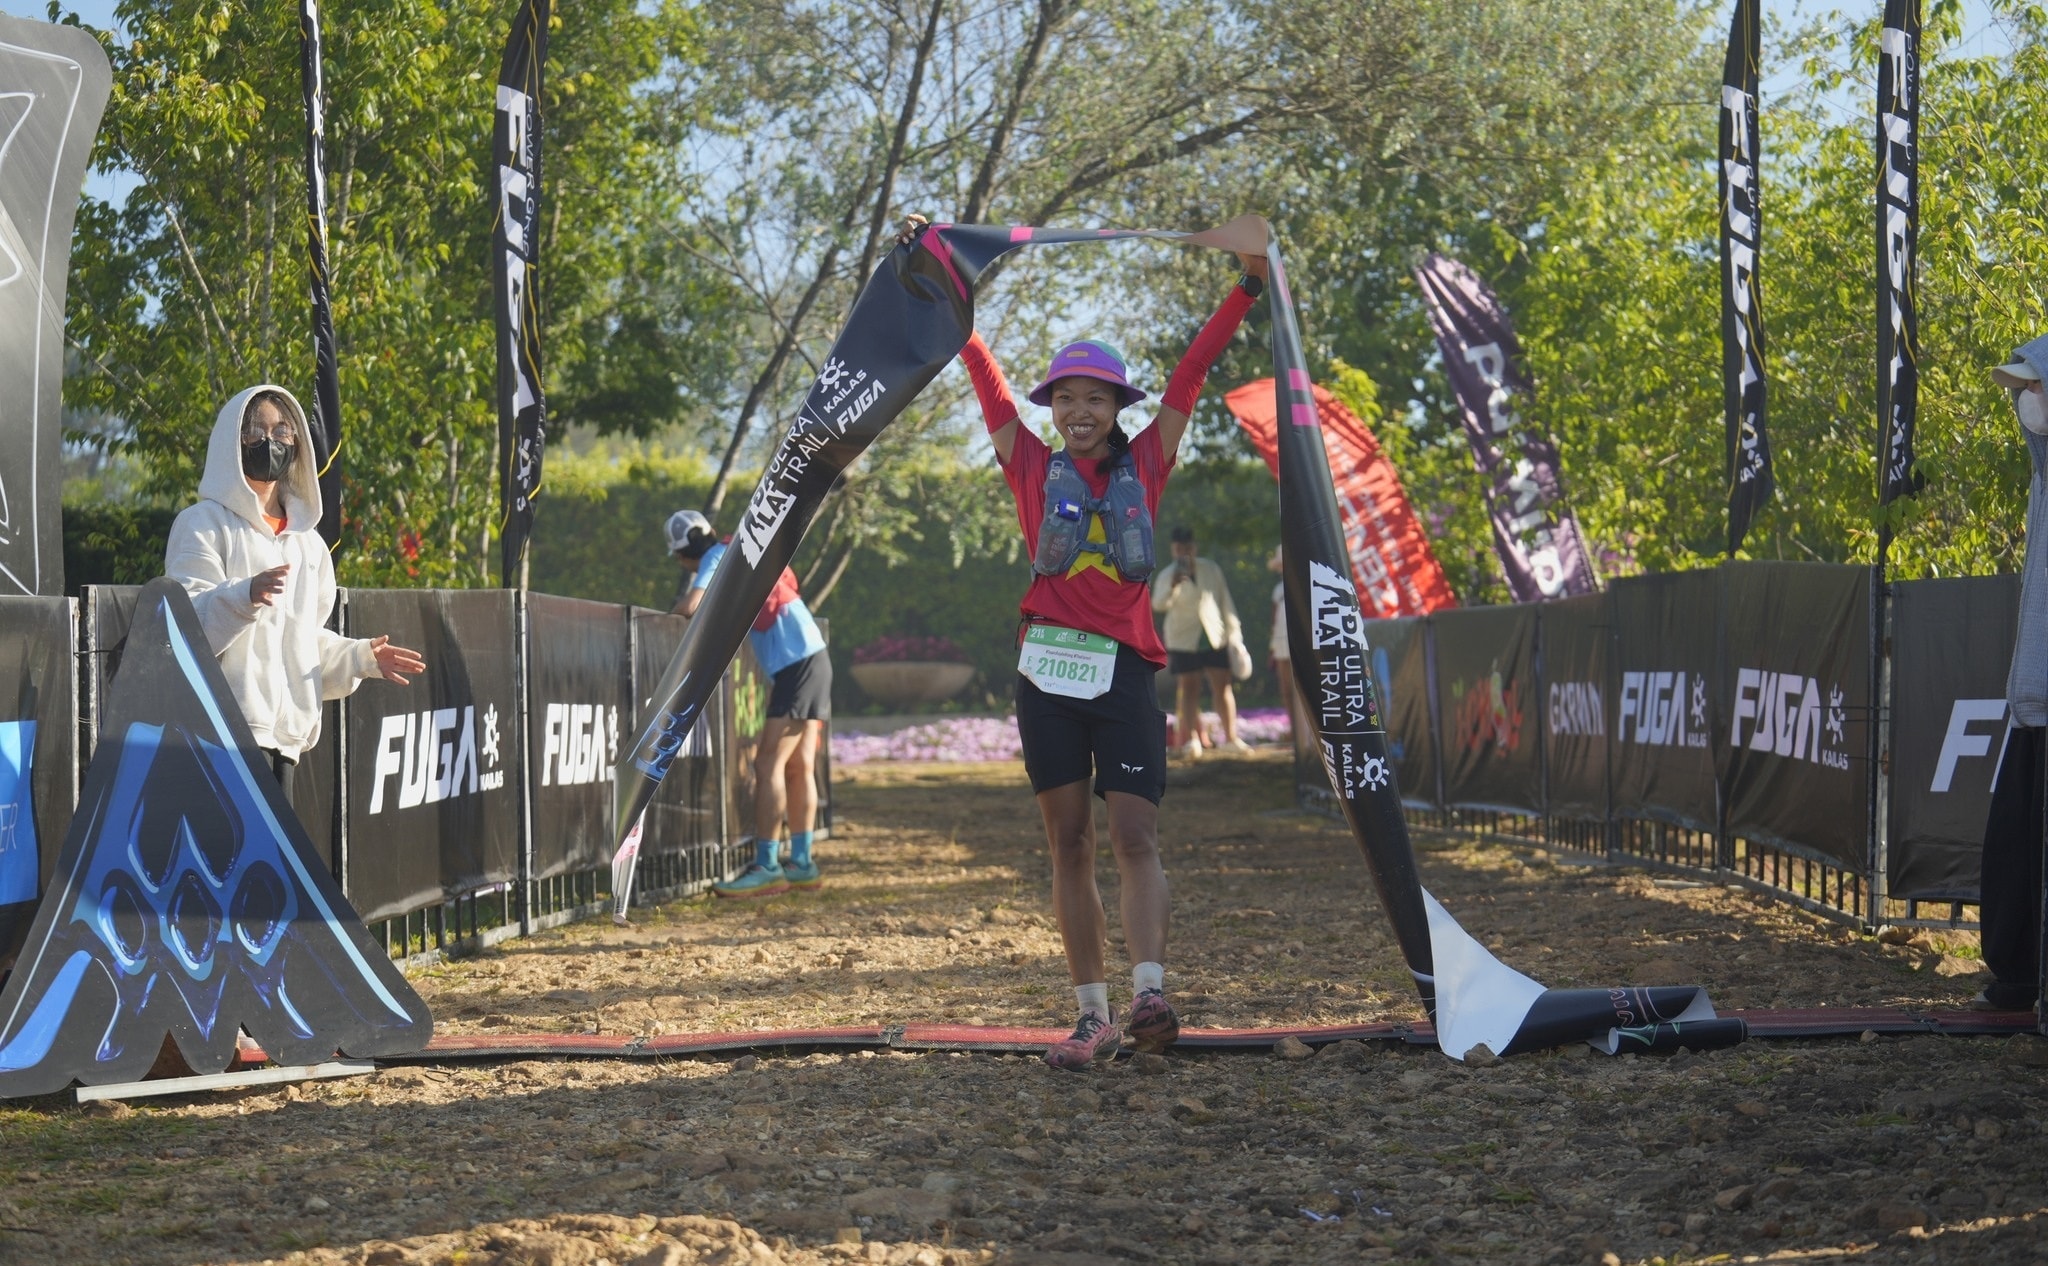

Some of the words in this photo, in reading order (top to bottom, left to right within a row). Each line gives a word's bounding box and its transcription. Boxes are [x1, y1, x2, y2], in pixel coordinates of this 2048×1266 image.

[823, 369, 867, 414] KAILAS
[836, 379, 887, 434] FUGA
[780, 432, 830, 484] TRAIL
[1036, 656, 1098, 684] 210821
[1319, 655, 1342, 727] TRAIL
[1343, 655, 1366, 727] ULTRA
[1618, 671, 1686, 747] FUGA
[1730, 667, 1821, 764] FUGA
[370, 705, 478, 815] FUGA
[542, 703, 606, 787] FUGA
[1342, 743, 1355, 800] KAILAS
[1822, 748, 1849, 771] KAILAS
